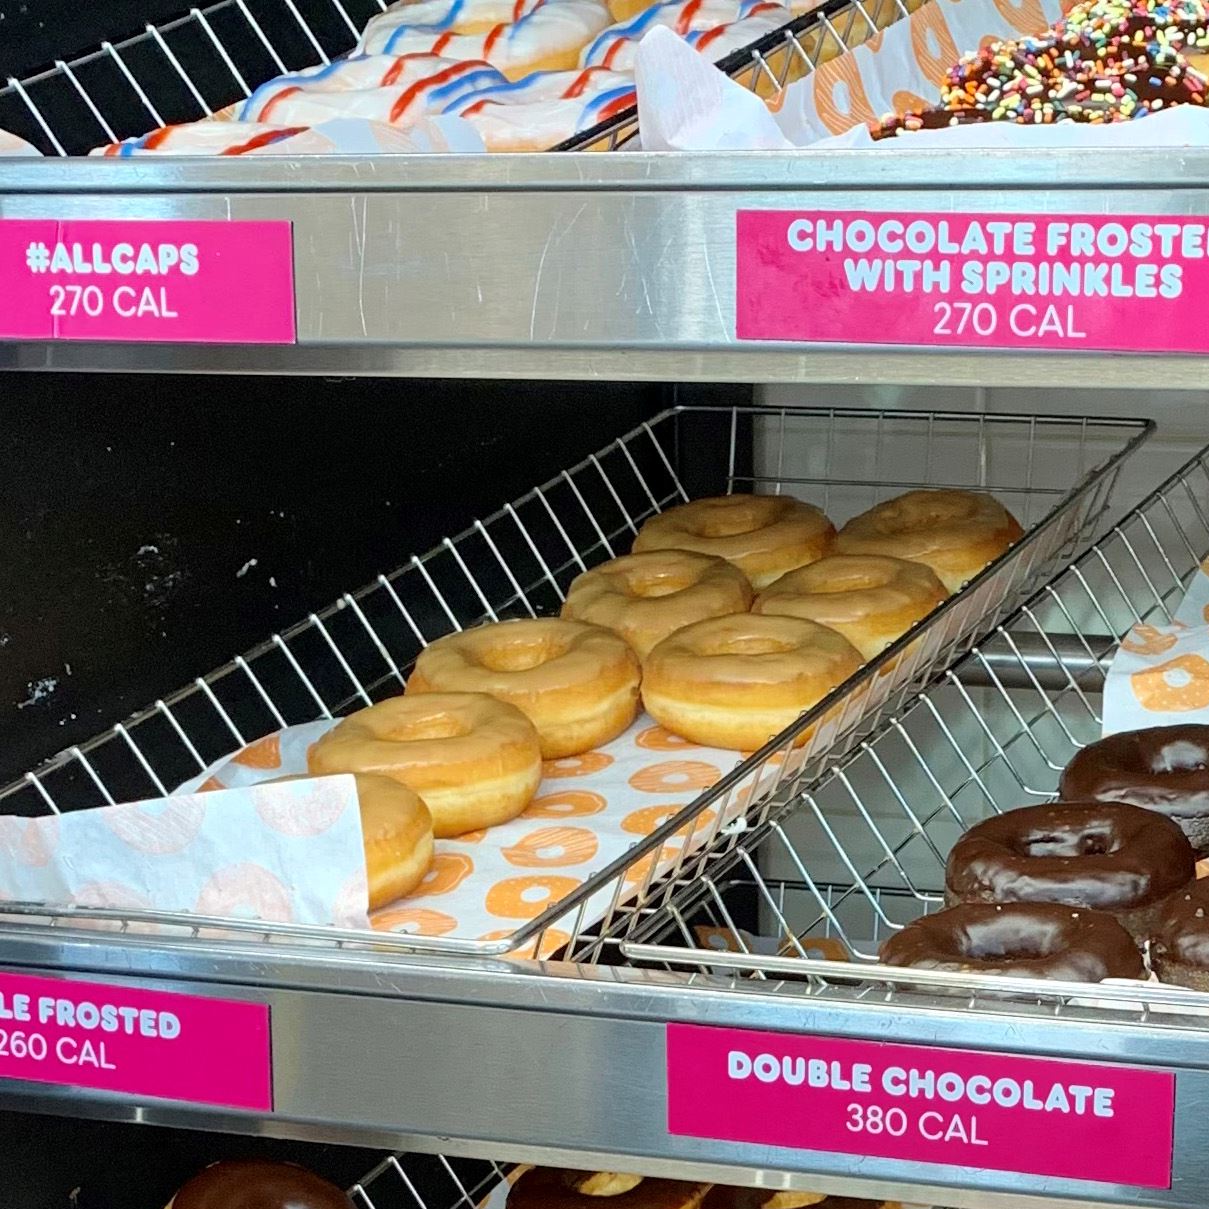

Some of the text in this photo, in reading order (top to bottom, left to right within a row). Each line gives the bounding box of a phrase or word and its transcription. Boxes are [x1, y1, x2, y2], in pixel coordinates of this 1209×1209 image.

[787, 218, 1037, 256] CHOCOLATE
[25, 241, 200, 276] #ALLCAPS
[843, 257, 1184, 300] WITH SPRINKLES
[49, 284, 178, 318] 270 CAL
[933, 301, 1087, 338] 270 CAL
[38, 996, 181, 1039] FROSTED
[0, 1028, 116, 1069] 260 CAL
[727, 1050, 1115, 1118] DOUBLE CHOCOLATE
[846, 1103, 989, 1146] 380 CAL
